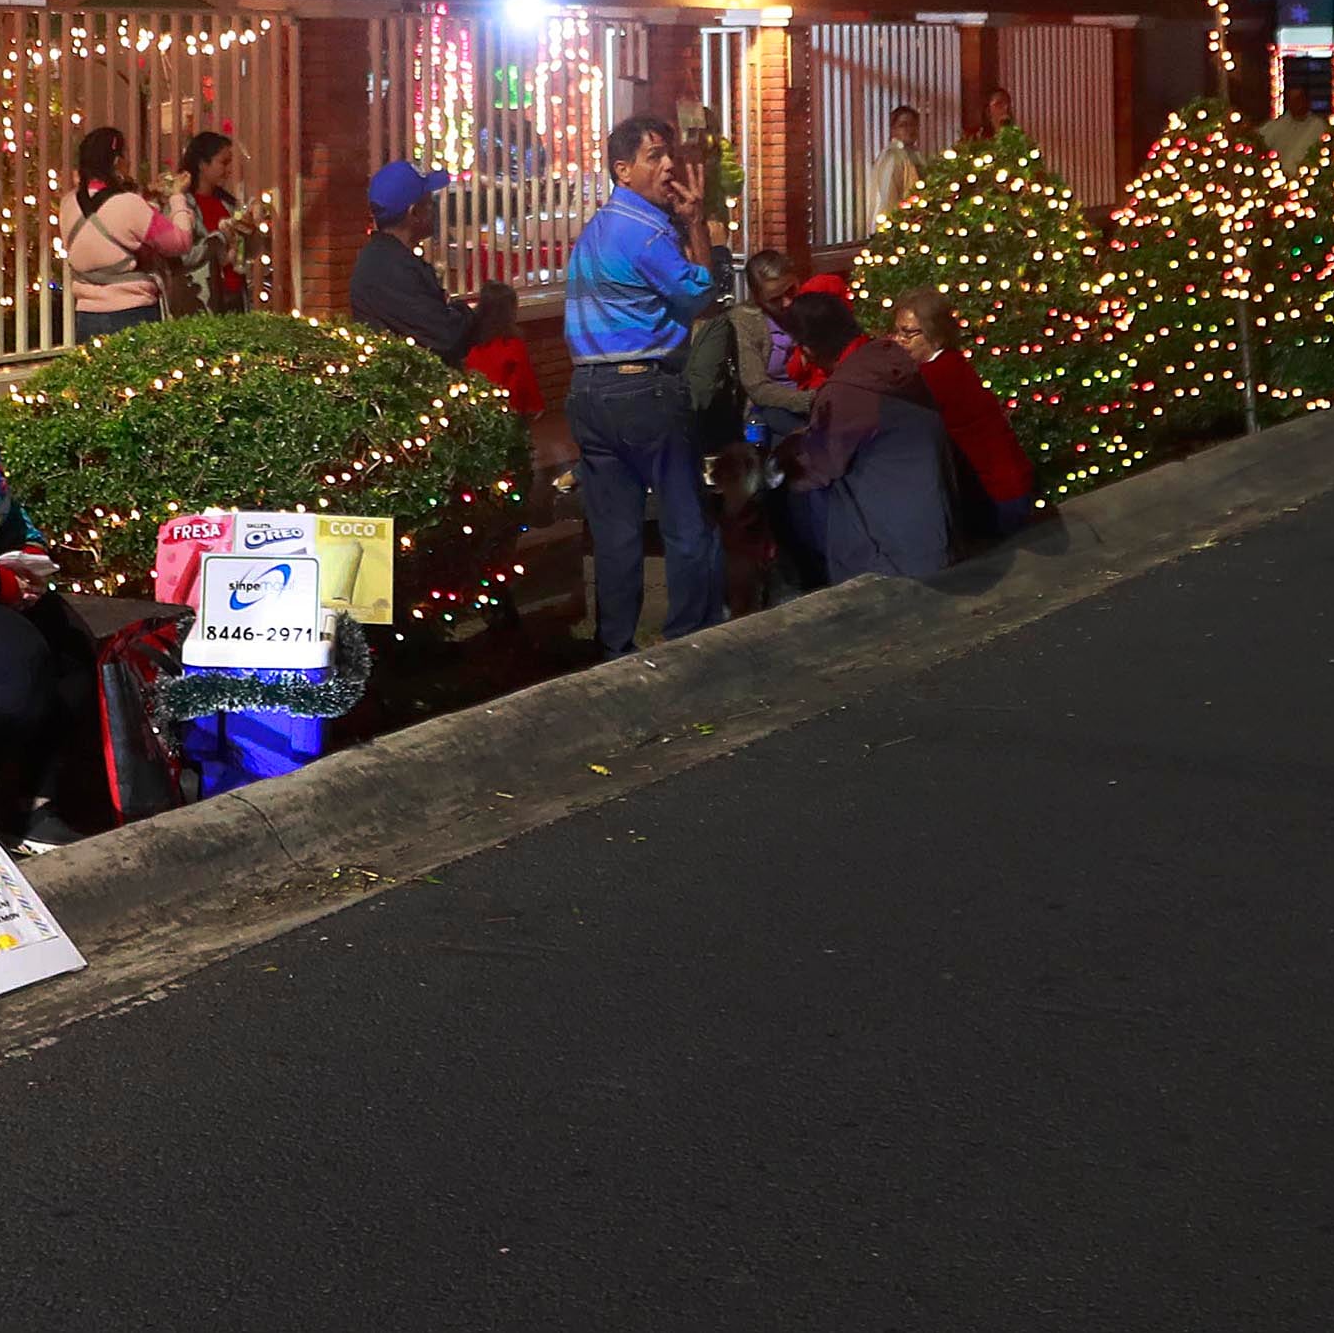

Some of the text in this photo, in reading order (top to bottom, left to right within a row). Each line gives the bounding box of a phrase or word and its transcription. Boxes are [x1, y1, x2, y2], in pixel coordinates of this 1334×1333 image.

[173, 523, 221, 540] FRESA
[330, 522, 377, 537] COCO
[244, 528, 304, 550] OREO
[206, 626, 313, 643] 8446-2971
